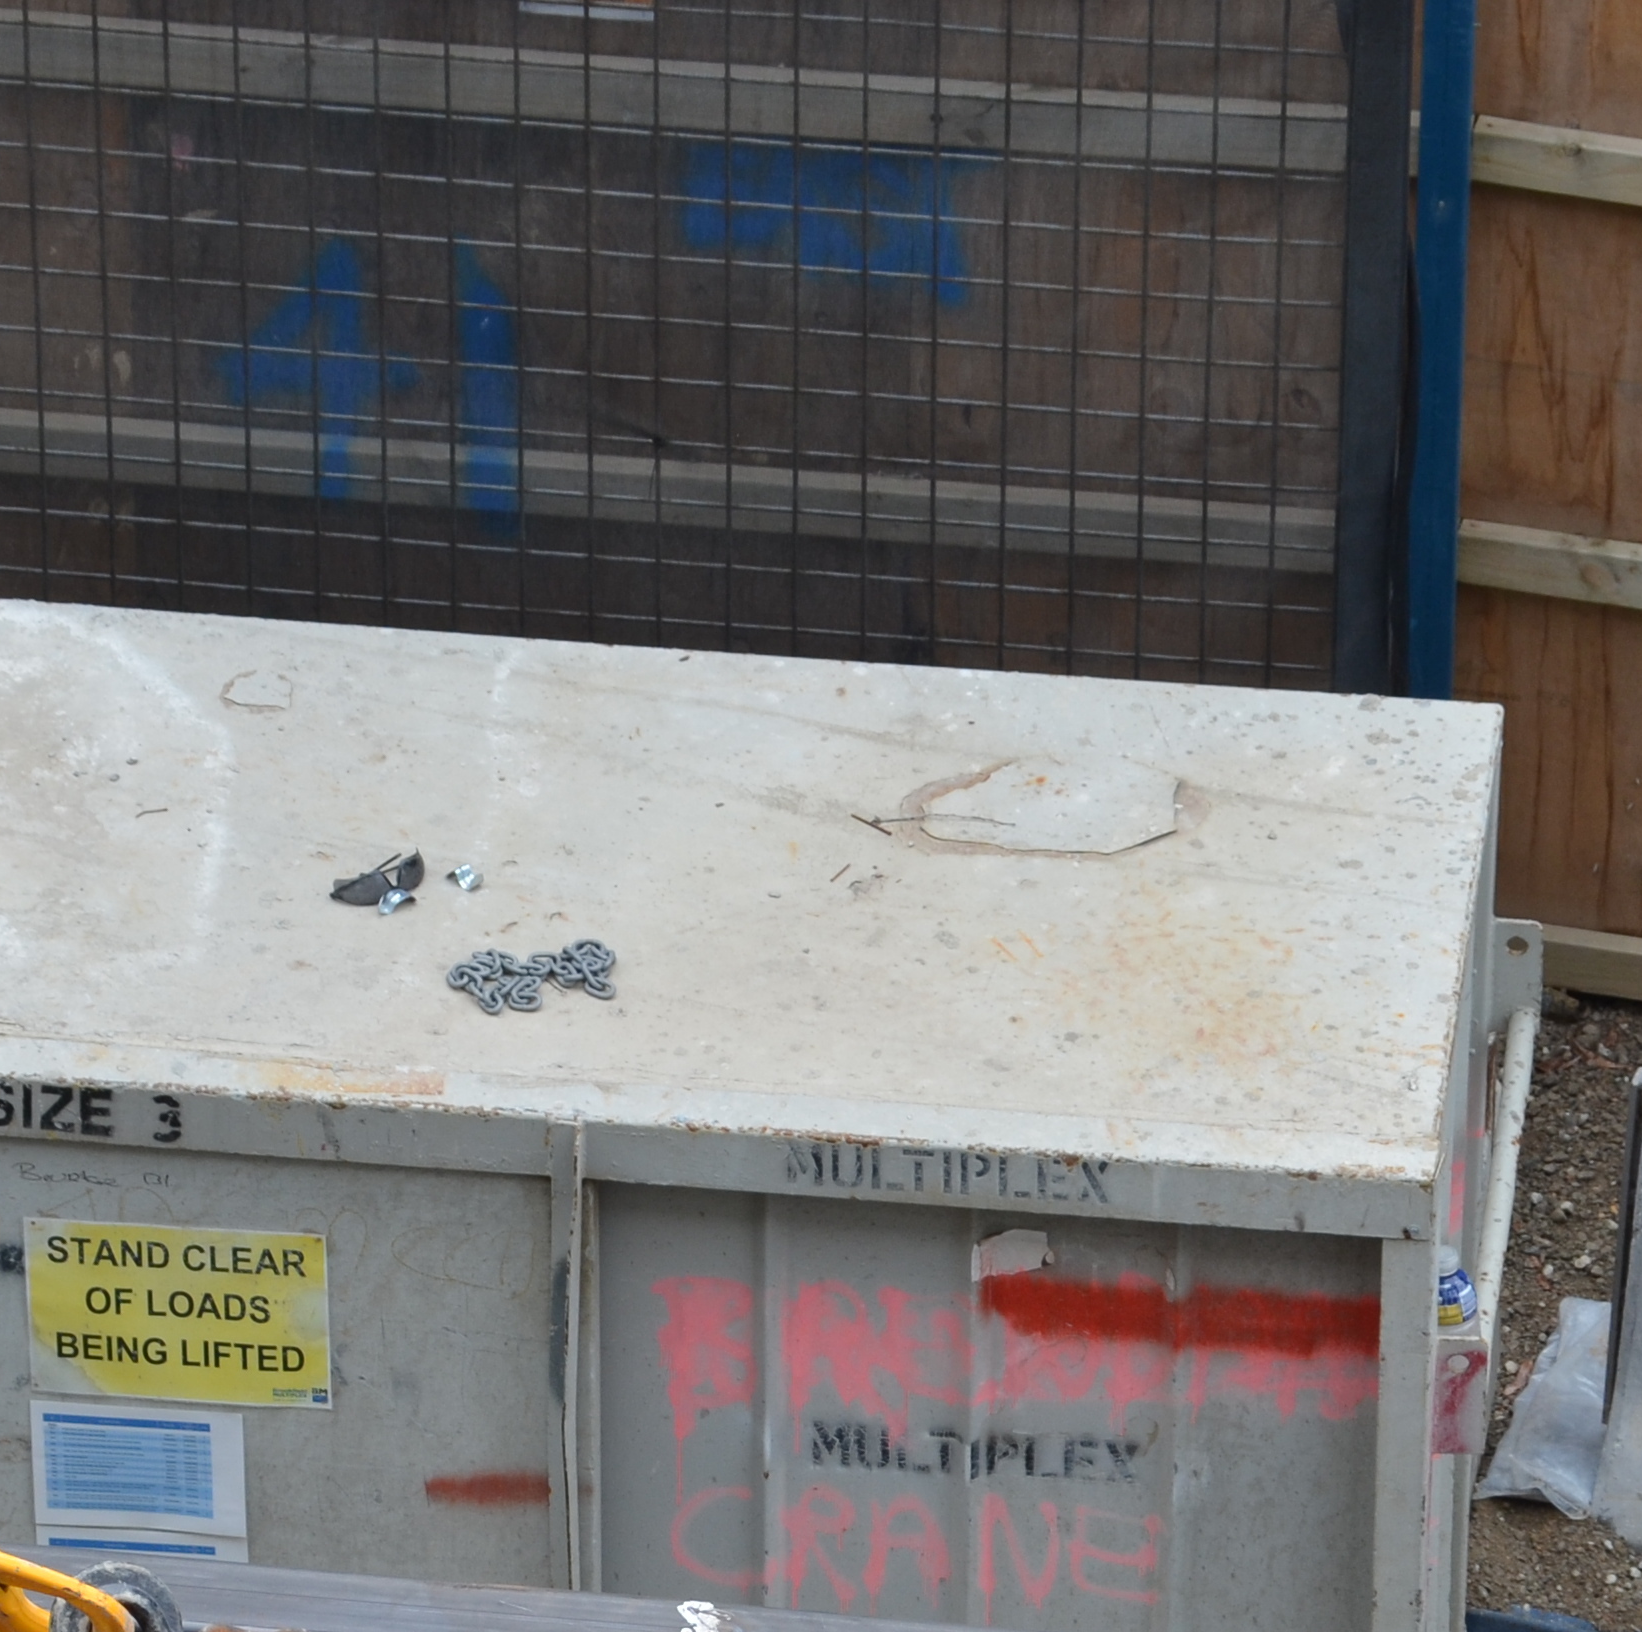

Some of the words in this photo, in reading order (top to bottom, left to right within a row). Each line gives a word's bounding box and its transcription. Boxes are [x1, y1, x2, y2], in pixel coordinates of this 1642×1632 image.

[786, 1142, 1113, 1204] MULTIPLEX
[47, 1235, 169, 1268] STAND
[182, 1244, 307, 1277] CLEAR
[86, 1286, 133, 1315] OF
[147, 1289, 271, 1324] LOADS
[56, 1332, 167, 1366] BEING
[181, 1339, 305, 1372] LIFTED
[810, 1418, 1143, 1483] MULTIPLEX
[669, 1484, 1157, 1608] CRANE
